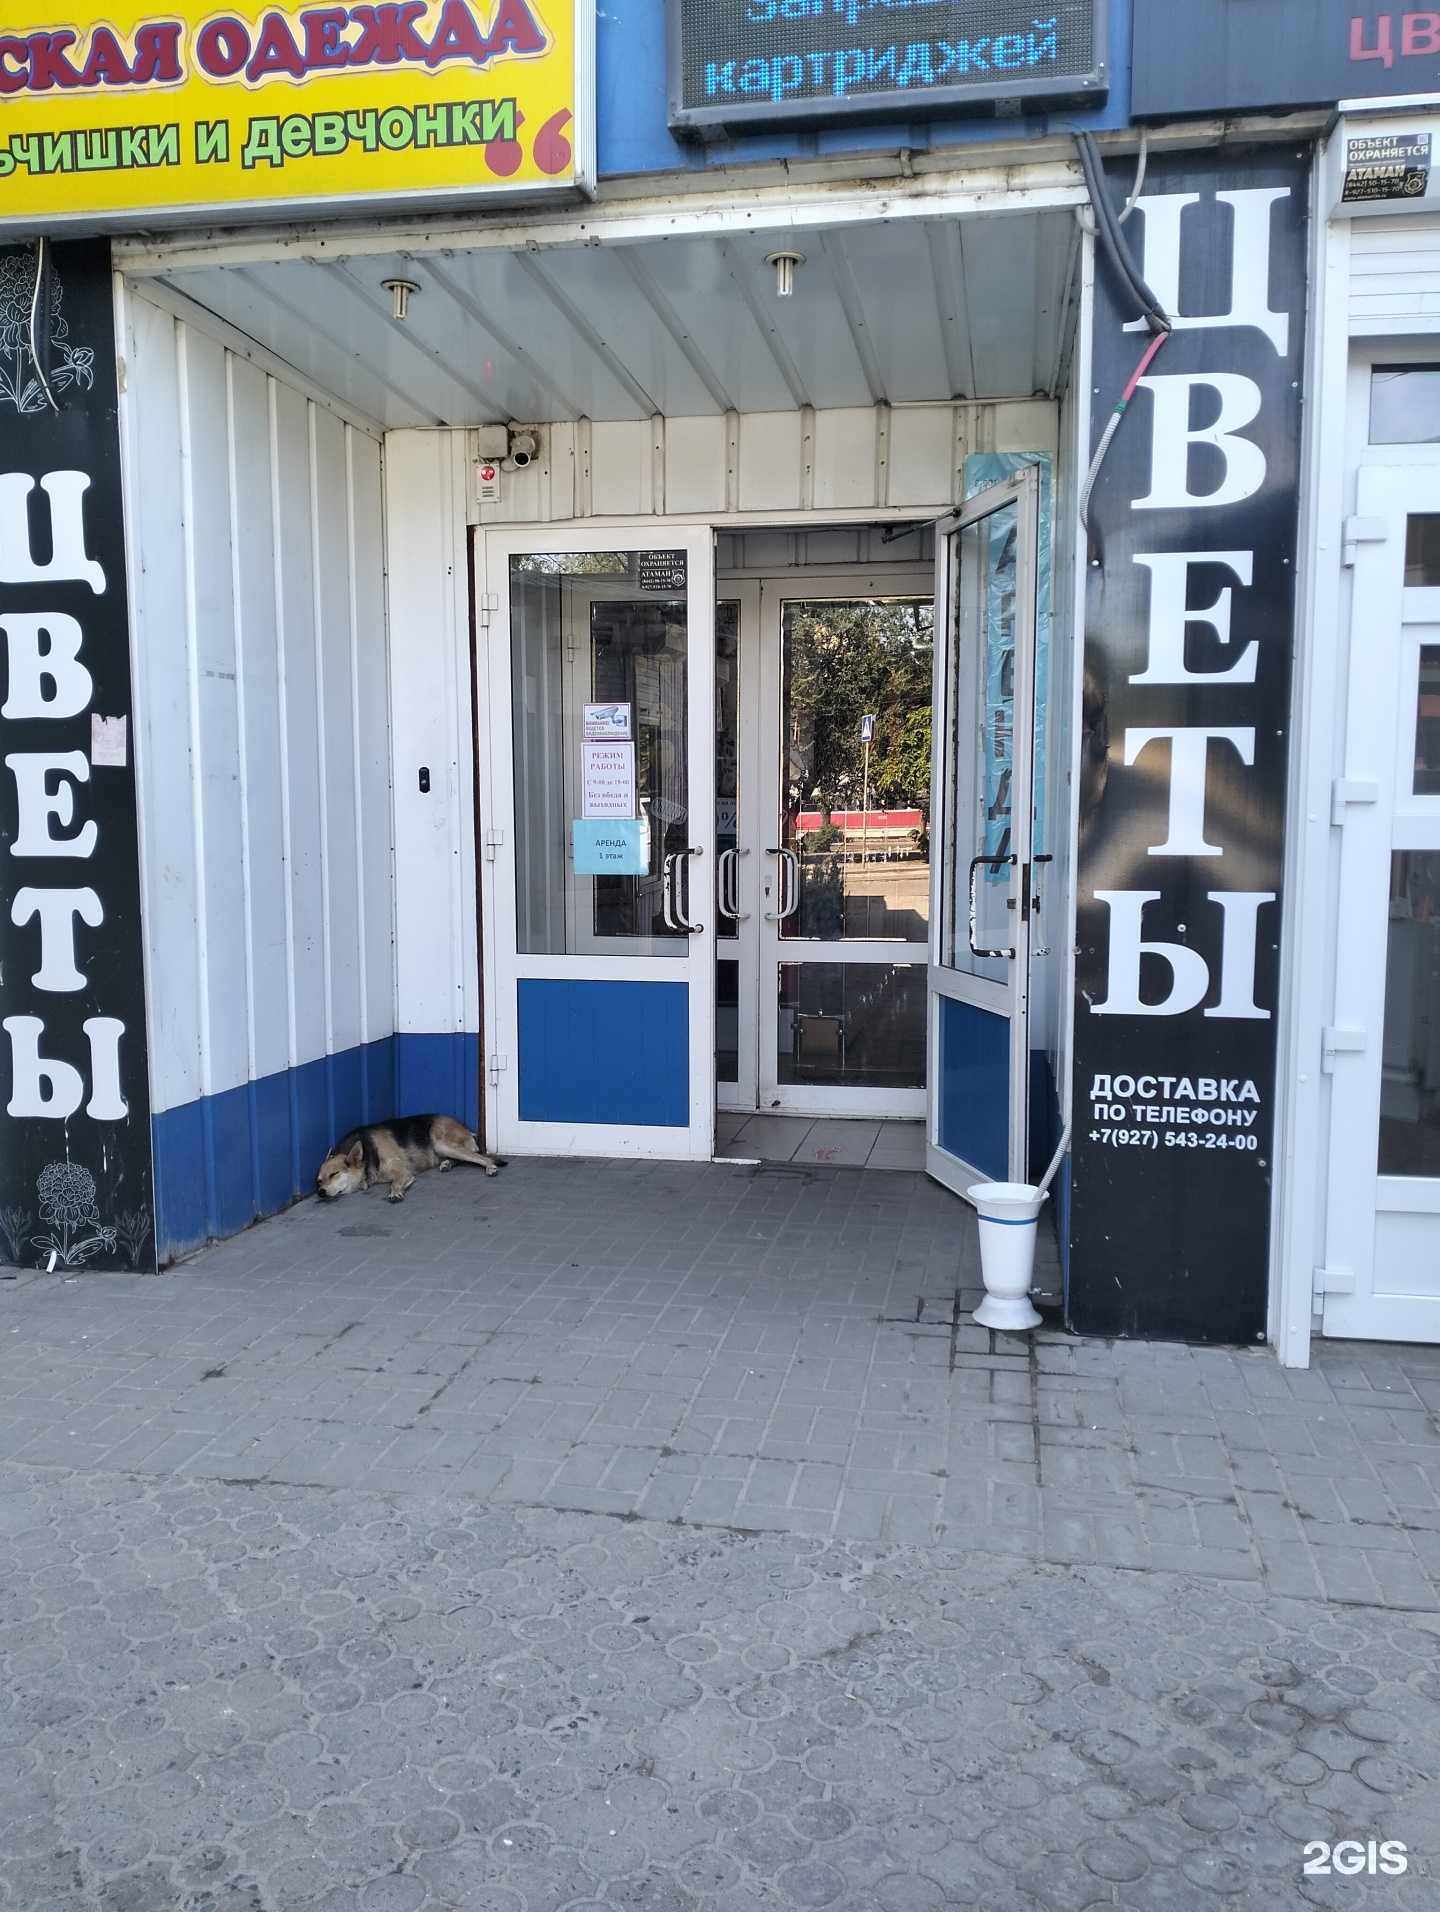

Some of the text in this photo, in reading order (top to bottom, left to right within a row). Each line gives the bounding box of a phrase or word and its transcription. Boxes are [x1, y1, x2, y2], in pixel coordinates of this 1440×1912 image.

[0, 0, 547, 93] СКАЯ ОДЕЖДА
[1350, 12, 1440, 69] ЦВ
[704, 17, 1057, 103] картриджей
[195, 119, 229, 164] и
[241, 97, 517, 170] девчонки
[1349, 137, 1399, 150] ОБЪЕКТ
[1349, 145, 1429, 160] ОХРАНЯЕТСЯ
[1347, 165, 1406, 180] АТАМАН
[1090, 187, 1291, 1020] ЦВЕТЫ
[591, 752, 624, 760] РЕЖИМ
[0, 471, 128, 1120] ЦВЕТЫ
[595, 839, 627, 848] АРЕНДА
[1089, 1074, 1261, 1103] ДОСТАВКА
[1094, 1104, 1258, 1127] ПО ТЕЛЕФОНУ
[1088, 1128, 1258, 1150] +7(927) 543-24-00
